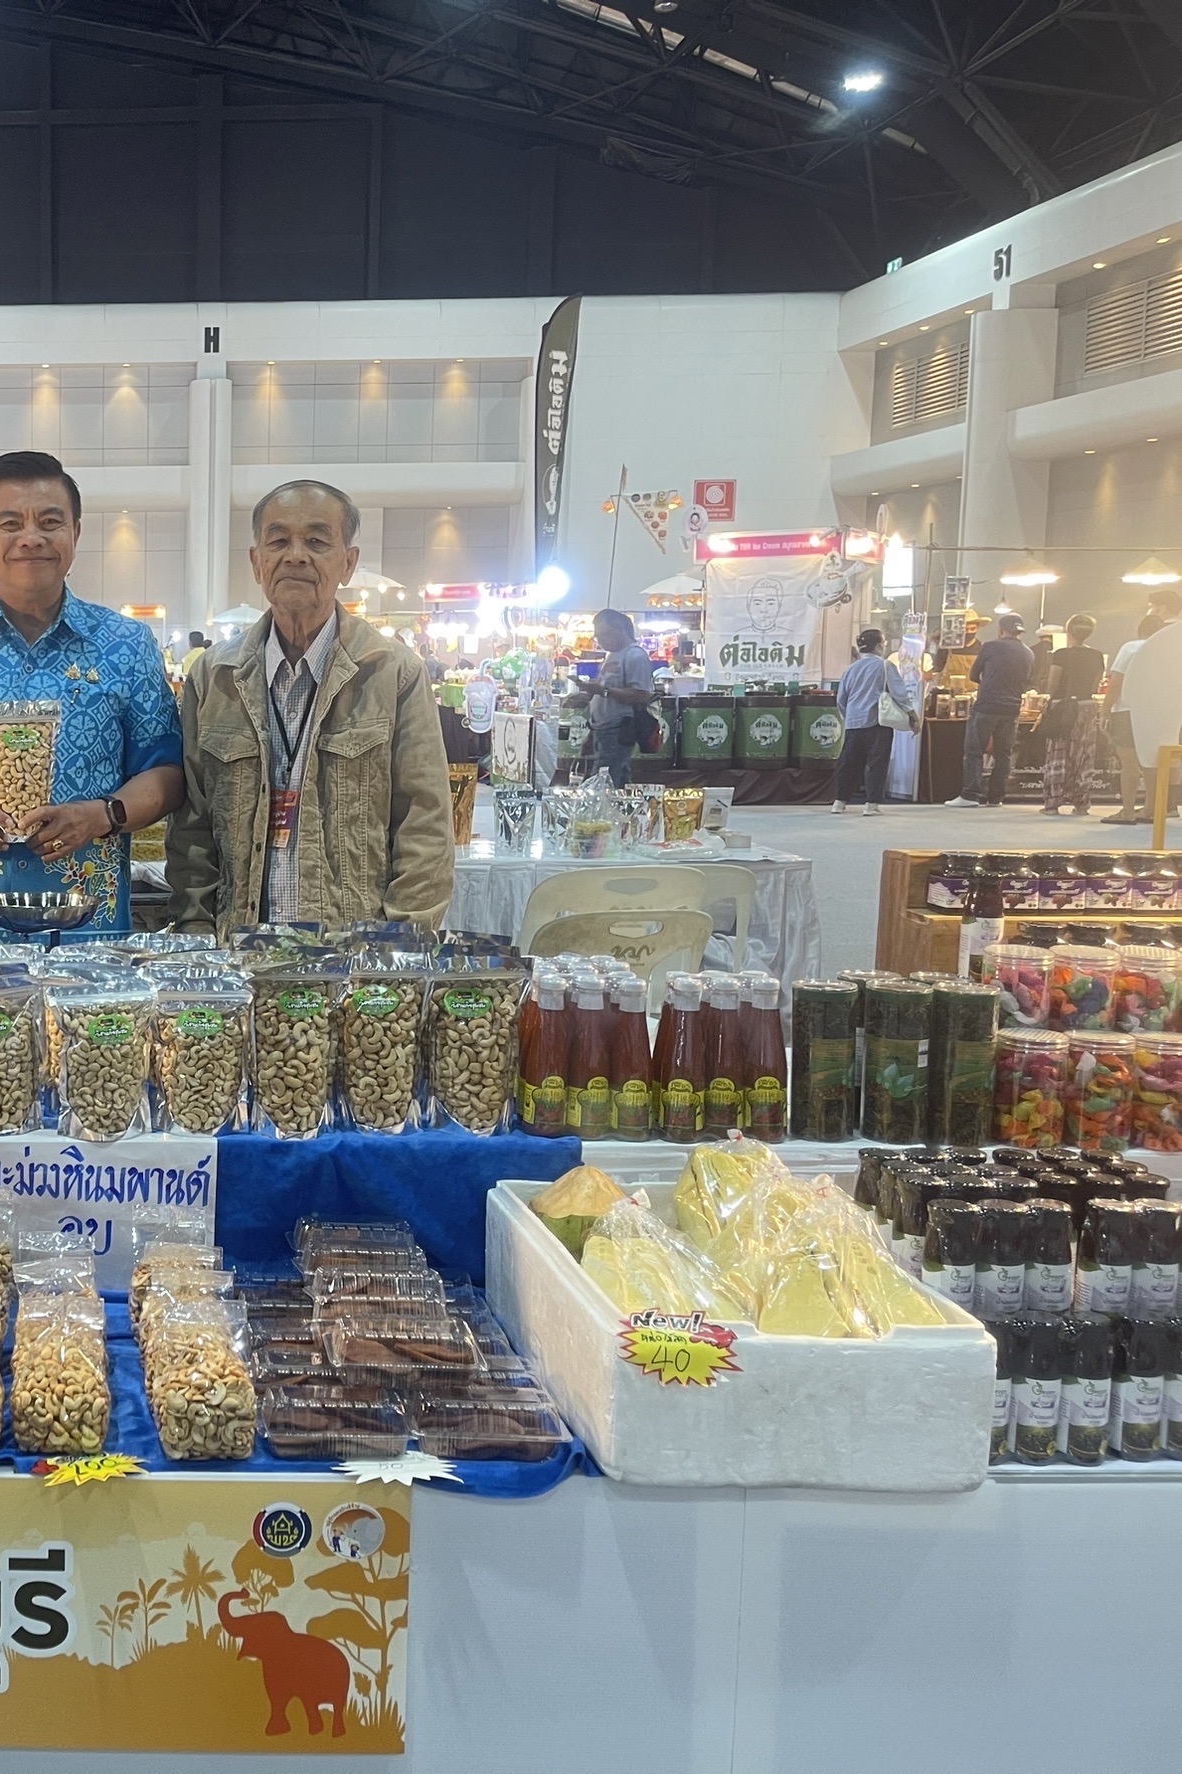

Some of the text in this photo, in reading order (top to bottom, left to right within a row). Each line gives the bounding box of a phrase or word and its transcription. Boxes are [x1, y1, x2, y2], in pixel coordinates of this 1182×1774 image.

[993, 244, 1012, 280] 51
[204, 327, 220, 353] H
[543, 349, 568, 455] ต่อไอติม
[719, 634, 805, 668] ต่อไอติม
[632, 1309, 703, 1332] New!
[651, 1345, 691, 1373] 40
